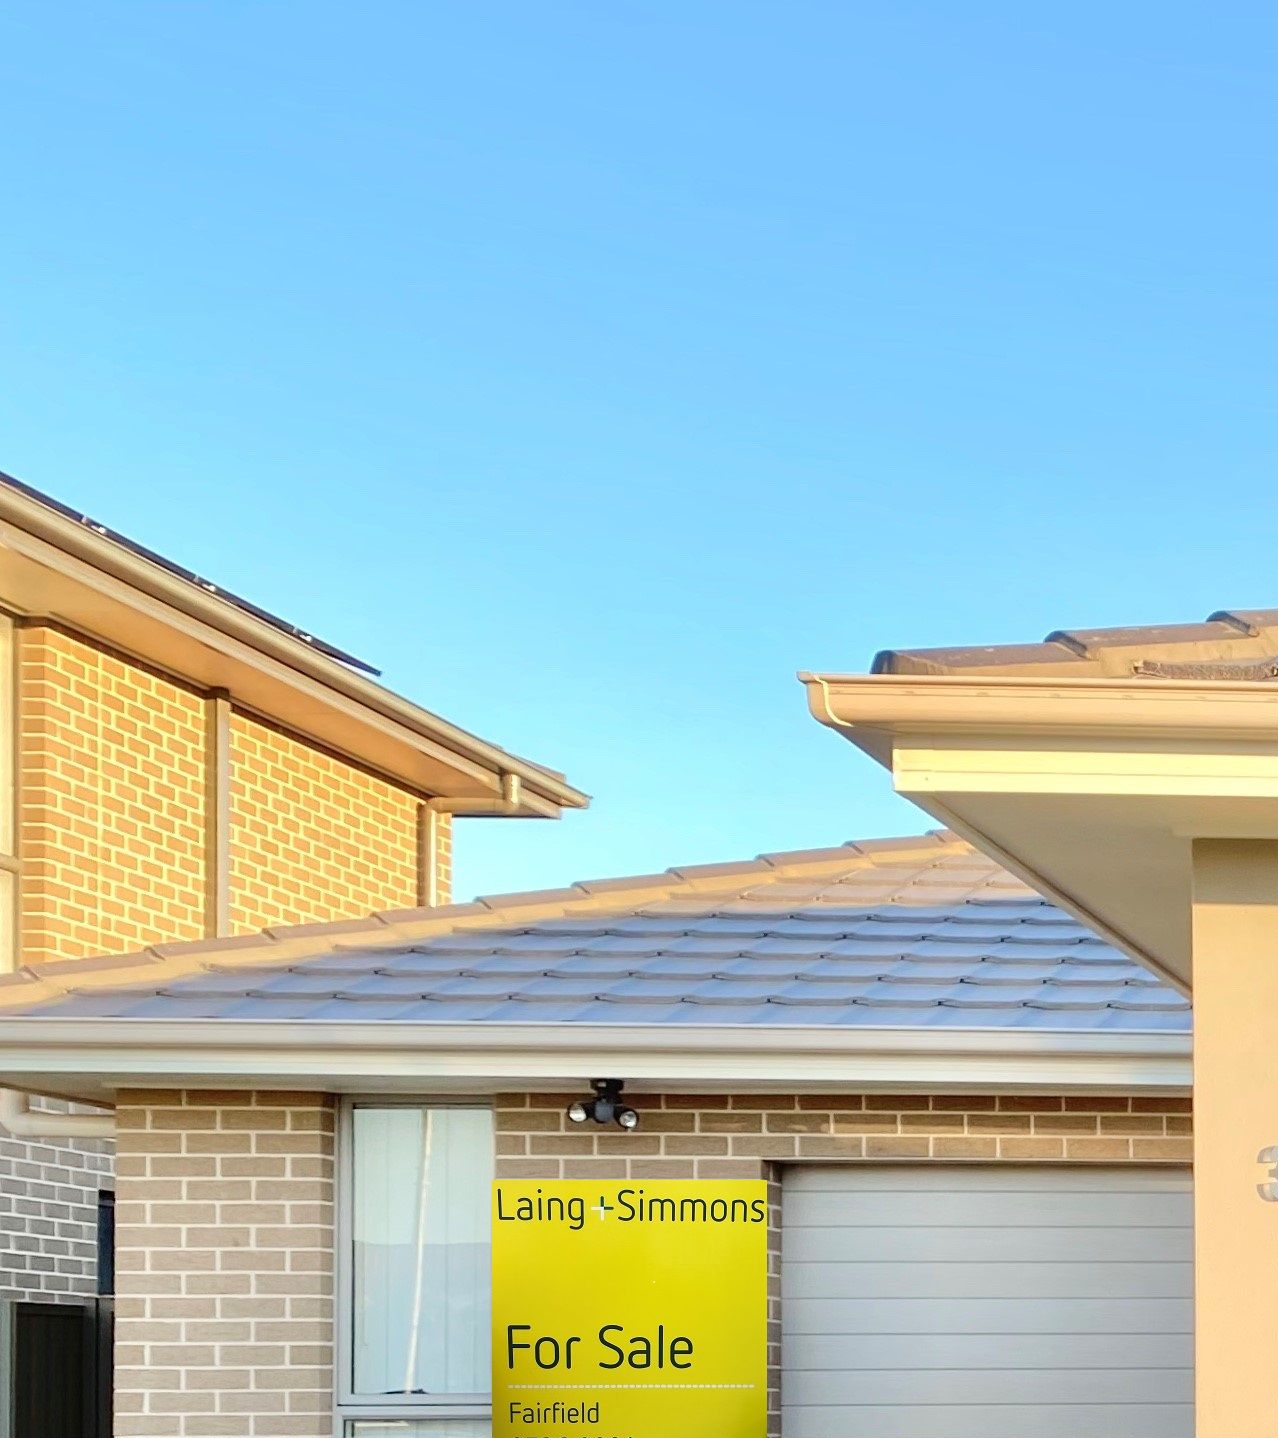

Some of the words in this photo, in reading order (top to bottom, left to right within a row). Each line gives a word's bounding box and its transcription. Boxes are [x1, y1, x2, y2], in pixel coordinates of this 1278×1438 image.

[508, 1325, 581, 1369] For
[599, 1325, 693, 1369] Sale
[510, 1402, 599, 1424] Fairfield
